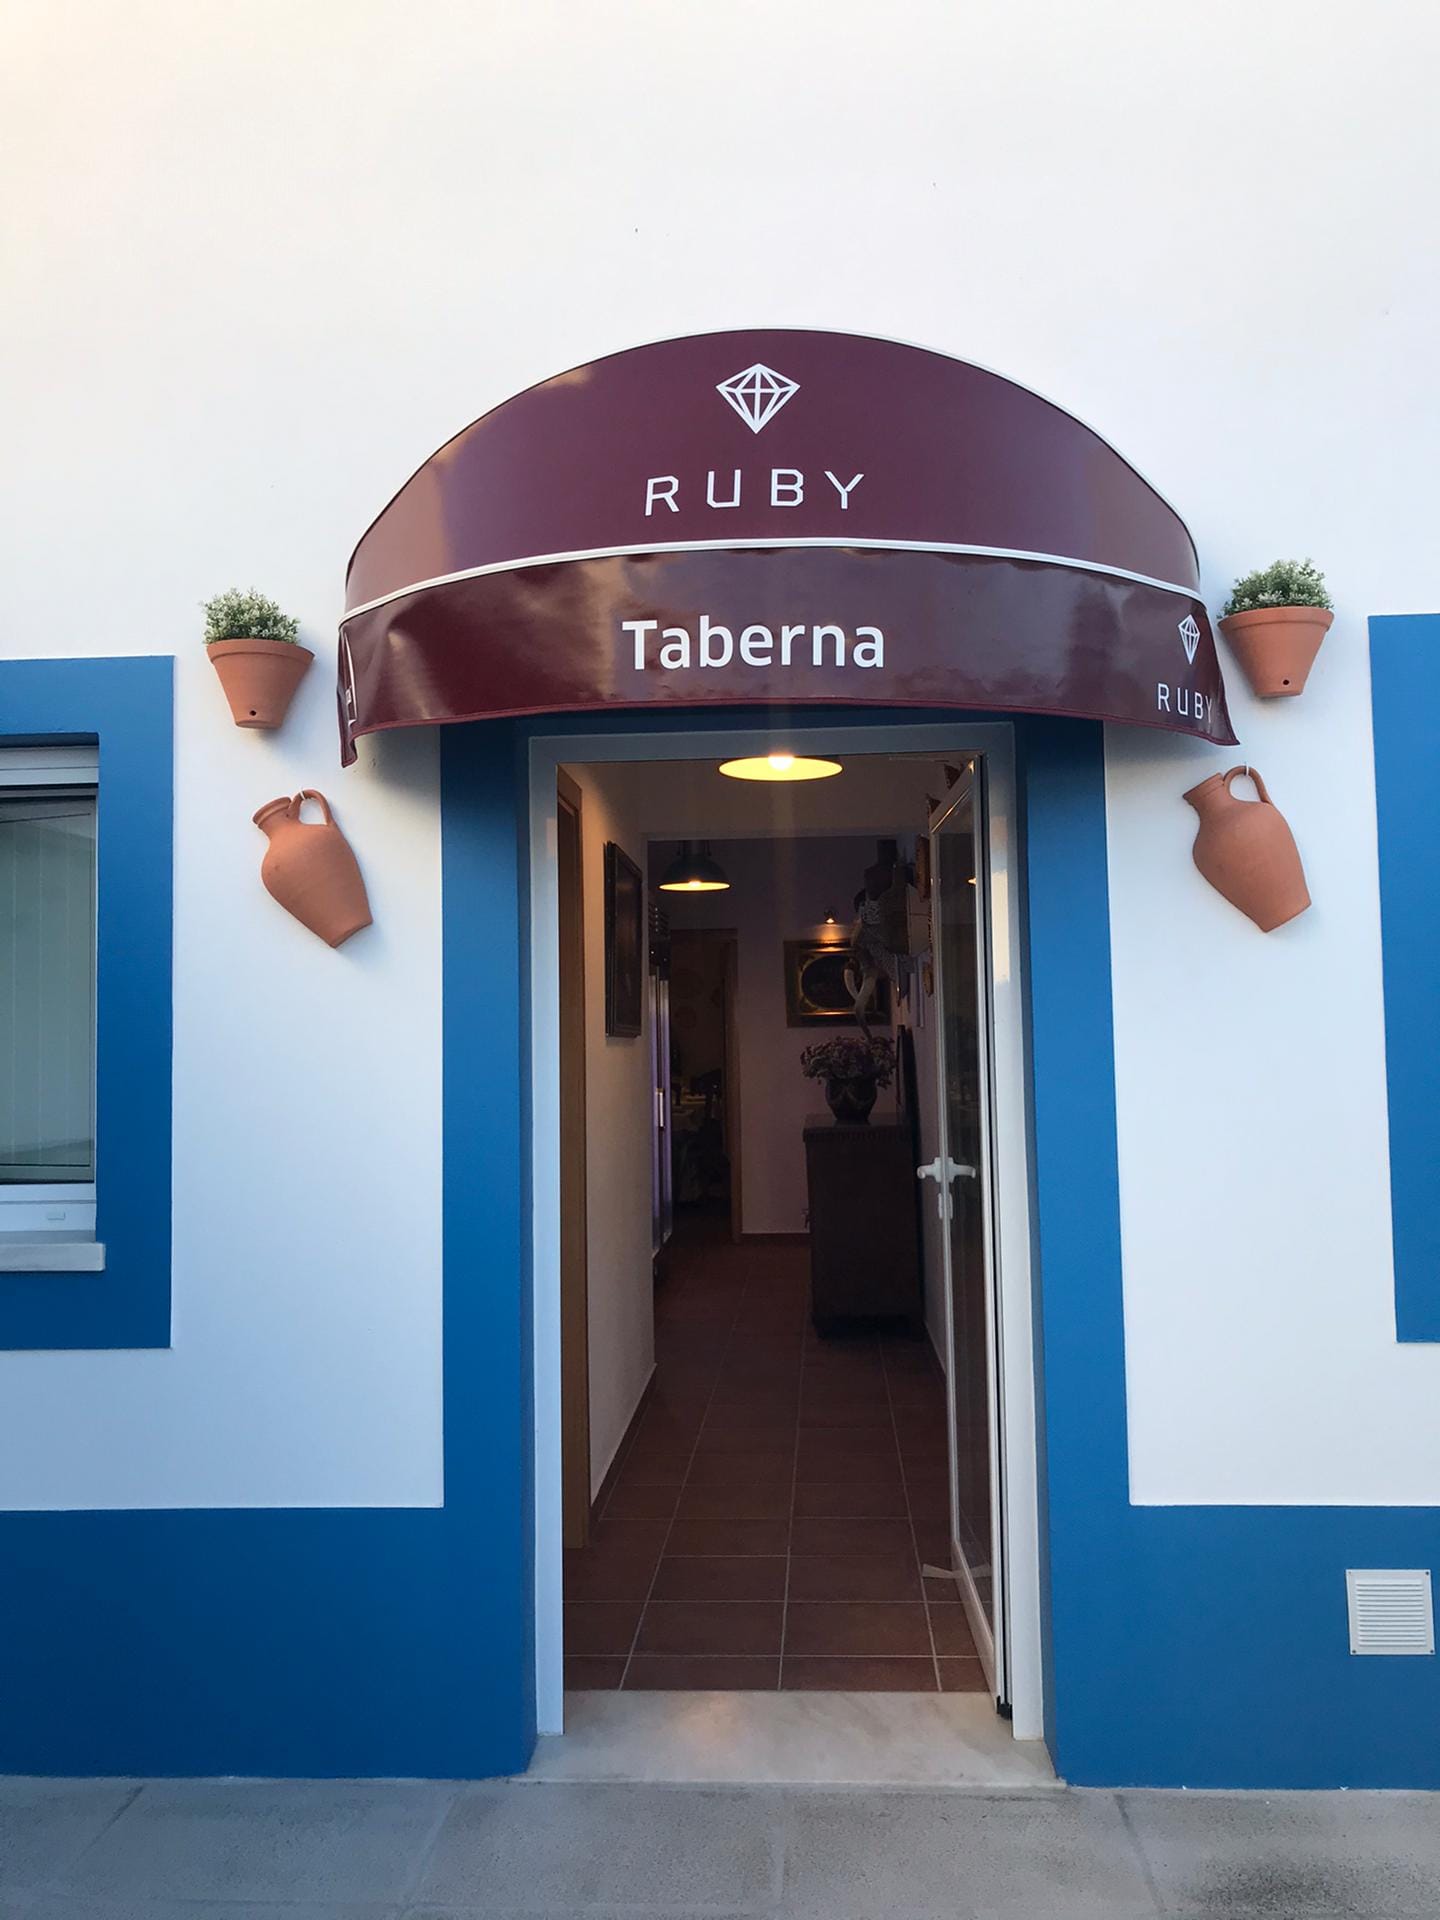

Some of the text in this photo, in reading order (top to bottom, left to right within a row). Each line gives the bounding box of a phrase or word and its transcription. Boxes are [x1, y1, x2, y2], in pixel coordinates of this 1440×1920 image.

[645, 468, 865, 517] RUBY
[622, 614, 885, 670] Taberna
[1157, 682, 1213, 724] RUBY
